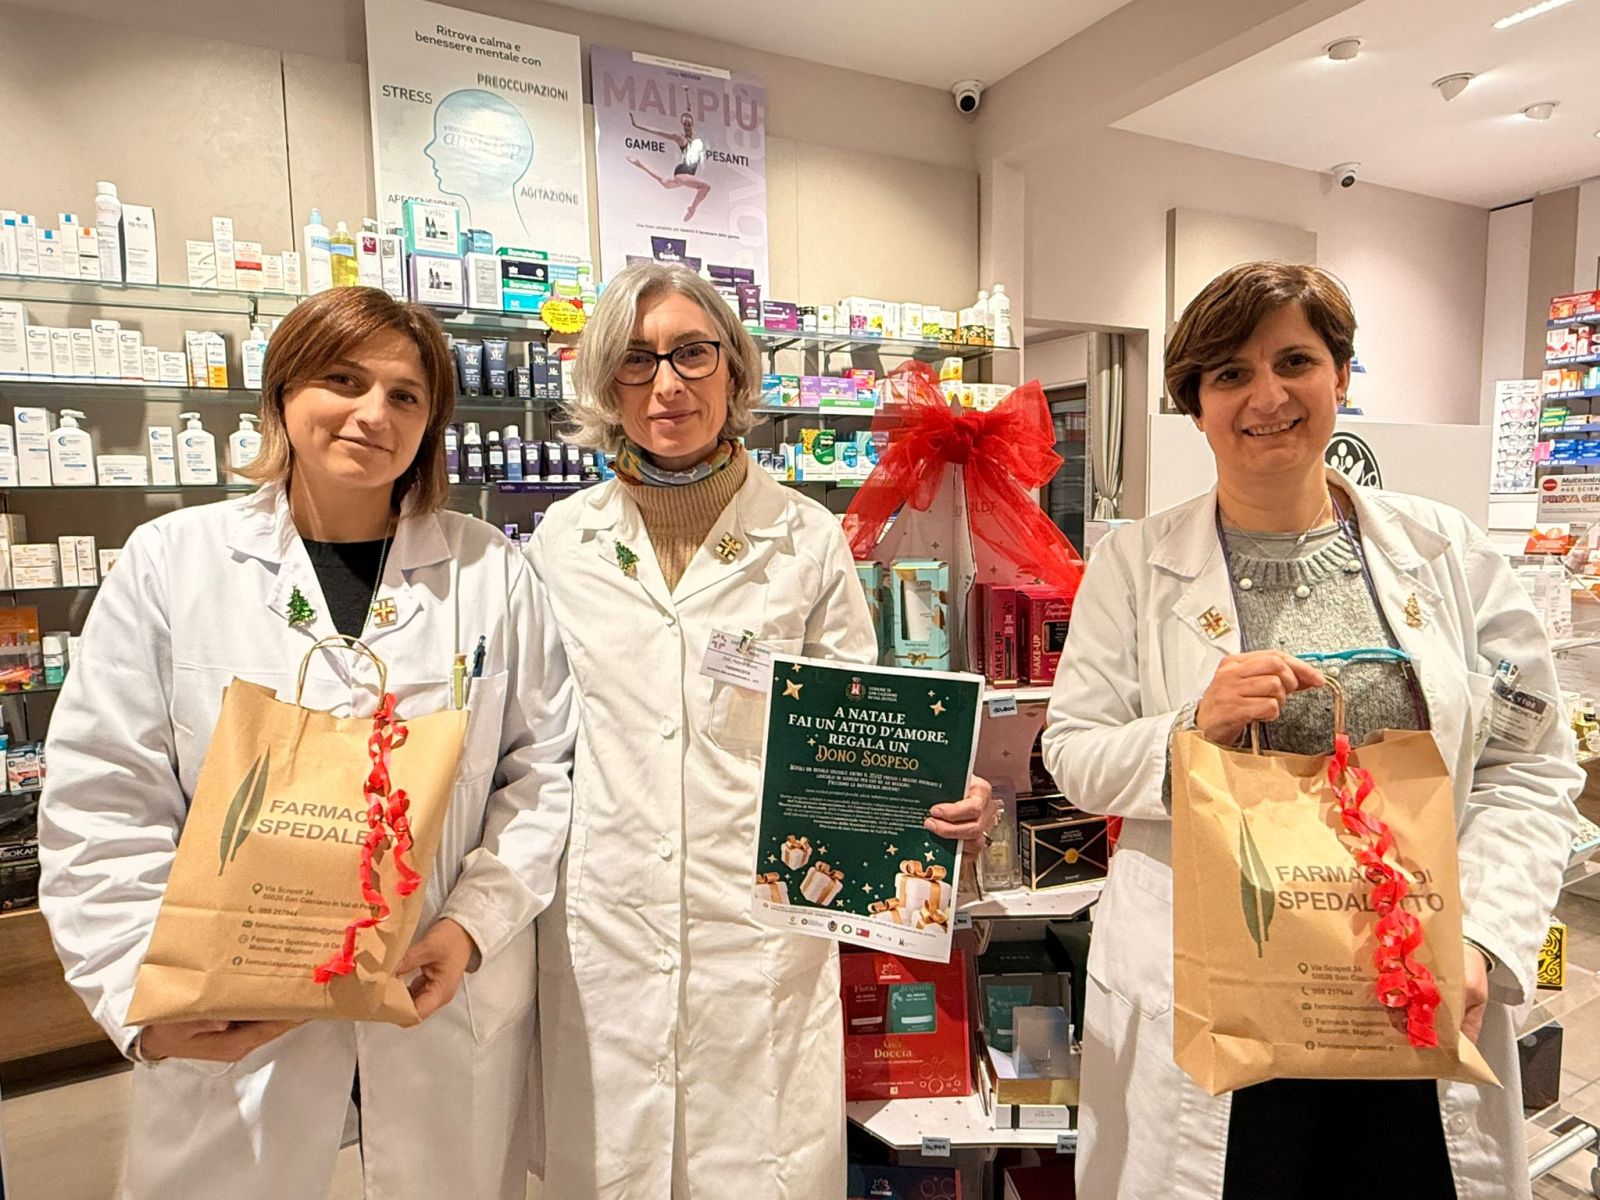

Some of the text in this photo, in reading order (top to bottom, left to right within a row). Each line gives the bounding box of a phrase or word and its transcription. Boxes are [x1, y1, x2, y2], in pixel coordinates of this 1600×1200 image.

[415, 31, 542, 68] benessere mentale con
[436, 24, 522, 52] Ritrova calma e
[382, 84, 433, 105] STRESS
[477, 72, 569, 101] PREOCCUPAZIONI
[602, 70, 759, 131] MAI PIÙ
[624, 137, 749, 167] GAMBE PESANTI
[520, 186, 579, 206] AGITAZIONE
[1567, 390, 1585, 398] testa
[1541, 494, 1580, 504] PROVA
[994, 631, 1004, 679] MAKE-UP
[1032, 634, 1041, 677] MAKE-UP
[788, 714, 949, 745] FAI UN ATTO D'AMORE,
[834, 706, 906, 726] A NATALE
[828, 733, 910, 754] REGALA UN
[815, 744, 920, 771] DONO SOSPESO
[269, 799, 386, 825] FARMAC
[1278, 890, 1445, 913] SPEDALTTO
